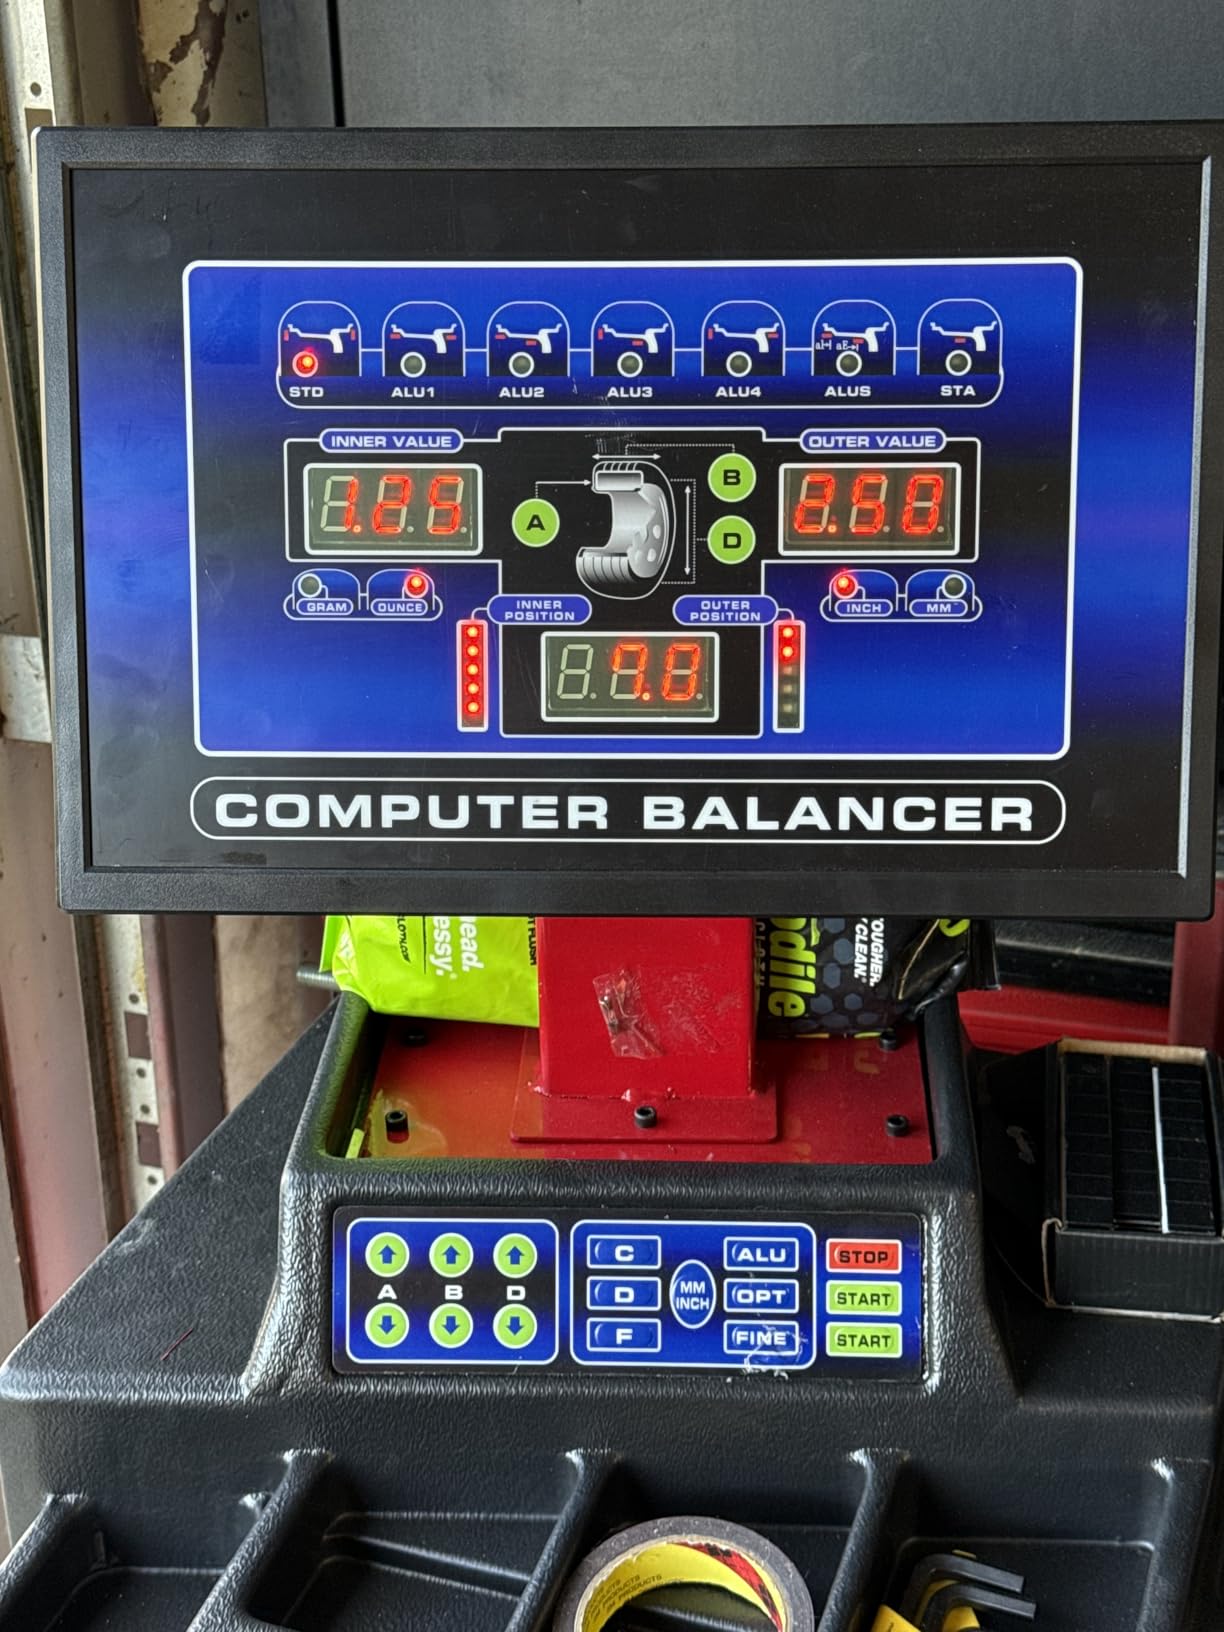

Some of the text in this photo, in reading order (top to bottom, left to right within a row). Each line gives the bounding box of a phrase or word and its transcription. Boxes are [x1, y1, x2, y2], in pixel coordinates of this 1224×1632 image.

[289, 386, 324, 398] STD
[391, 386, 435, 398] ALU1
[499, 386, 545, 398] ALU2
[607, 386, 653, 398] ALU3
[715, 386, 762, 398] ALU4
[940, 385, 976, 397] STA
[331, 435, 453, 448] INNER VALUE
[808, 434, 937, 449] OUTER VALUE
[723, 469, 741, 486] B
[793, 473, 944, 534] 2.50
[526, 514, 546, 531] A
[723, 532, 742, 549] D
[306, 602, 348, 613] GRAM
[377, 602, 423, 614] OUNCE
[516, 599, 562, 610] INNER
[700, 600, 750, 610] OUTER
[846, 603, 882, 614] INCH
[926, 602, 951, 613] MM
[504, 611, 575, 621] POSITION
[690, 611, 761, 622] POSITION
[215, 793, 1033, 832] COMPUTER BALANCER
[869, 918, 885, 987] OUGHER.
[614, 1245, 634, 1262] C
[737, 1248, 786, 1263] ALU
[838, 1250, 889, 1264] STOP
[377, 1284, 397, 1300] A
[444, 1285, 463, 1300] B
[506, 1285, 526, 1300] D
[680, 1281, 705, 1294] MM
[614, 1286, 635, 1304] D
[736, 1289, 786, 1304] OPT
[836, 1292, 891, 1307] START
[675, 1297, 710, 1311] INCH
[616, 1328, 633, 1345] F
[736, 1330, 786, 1346] FINE
[836, 1334, 891, 1349] START
